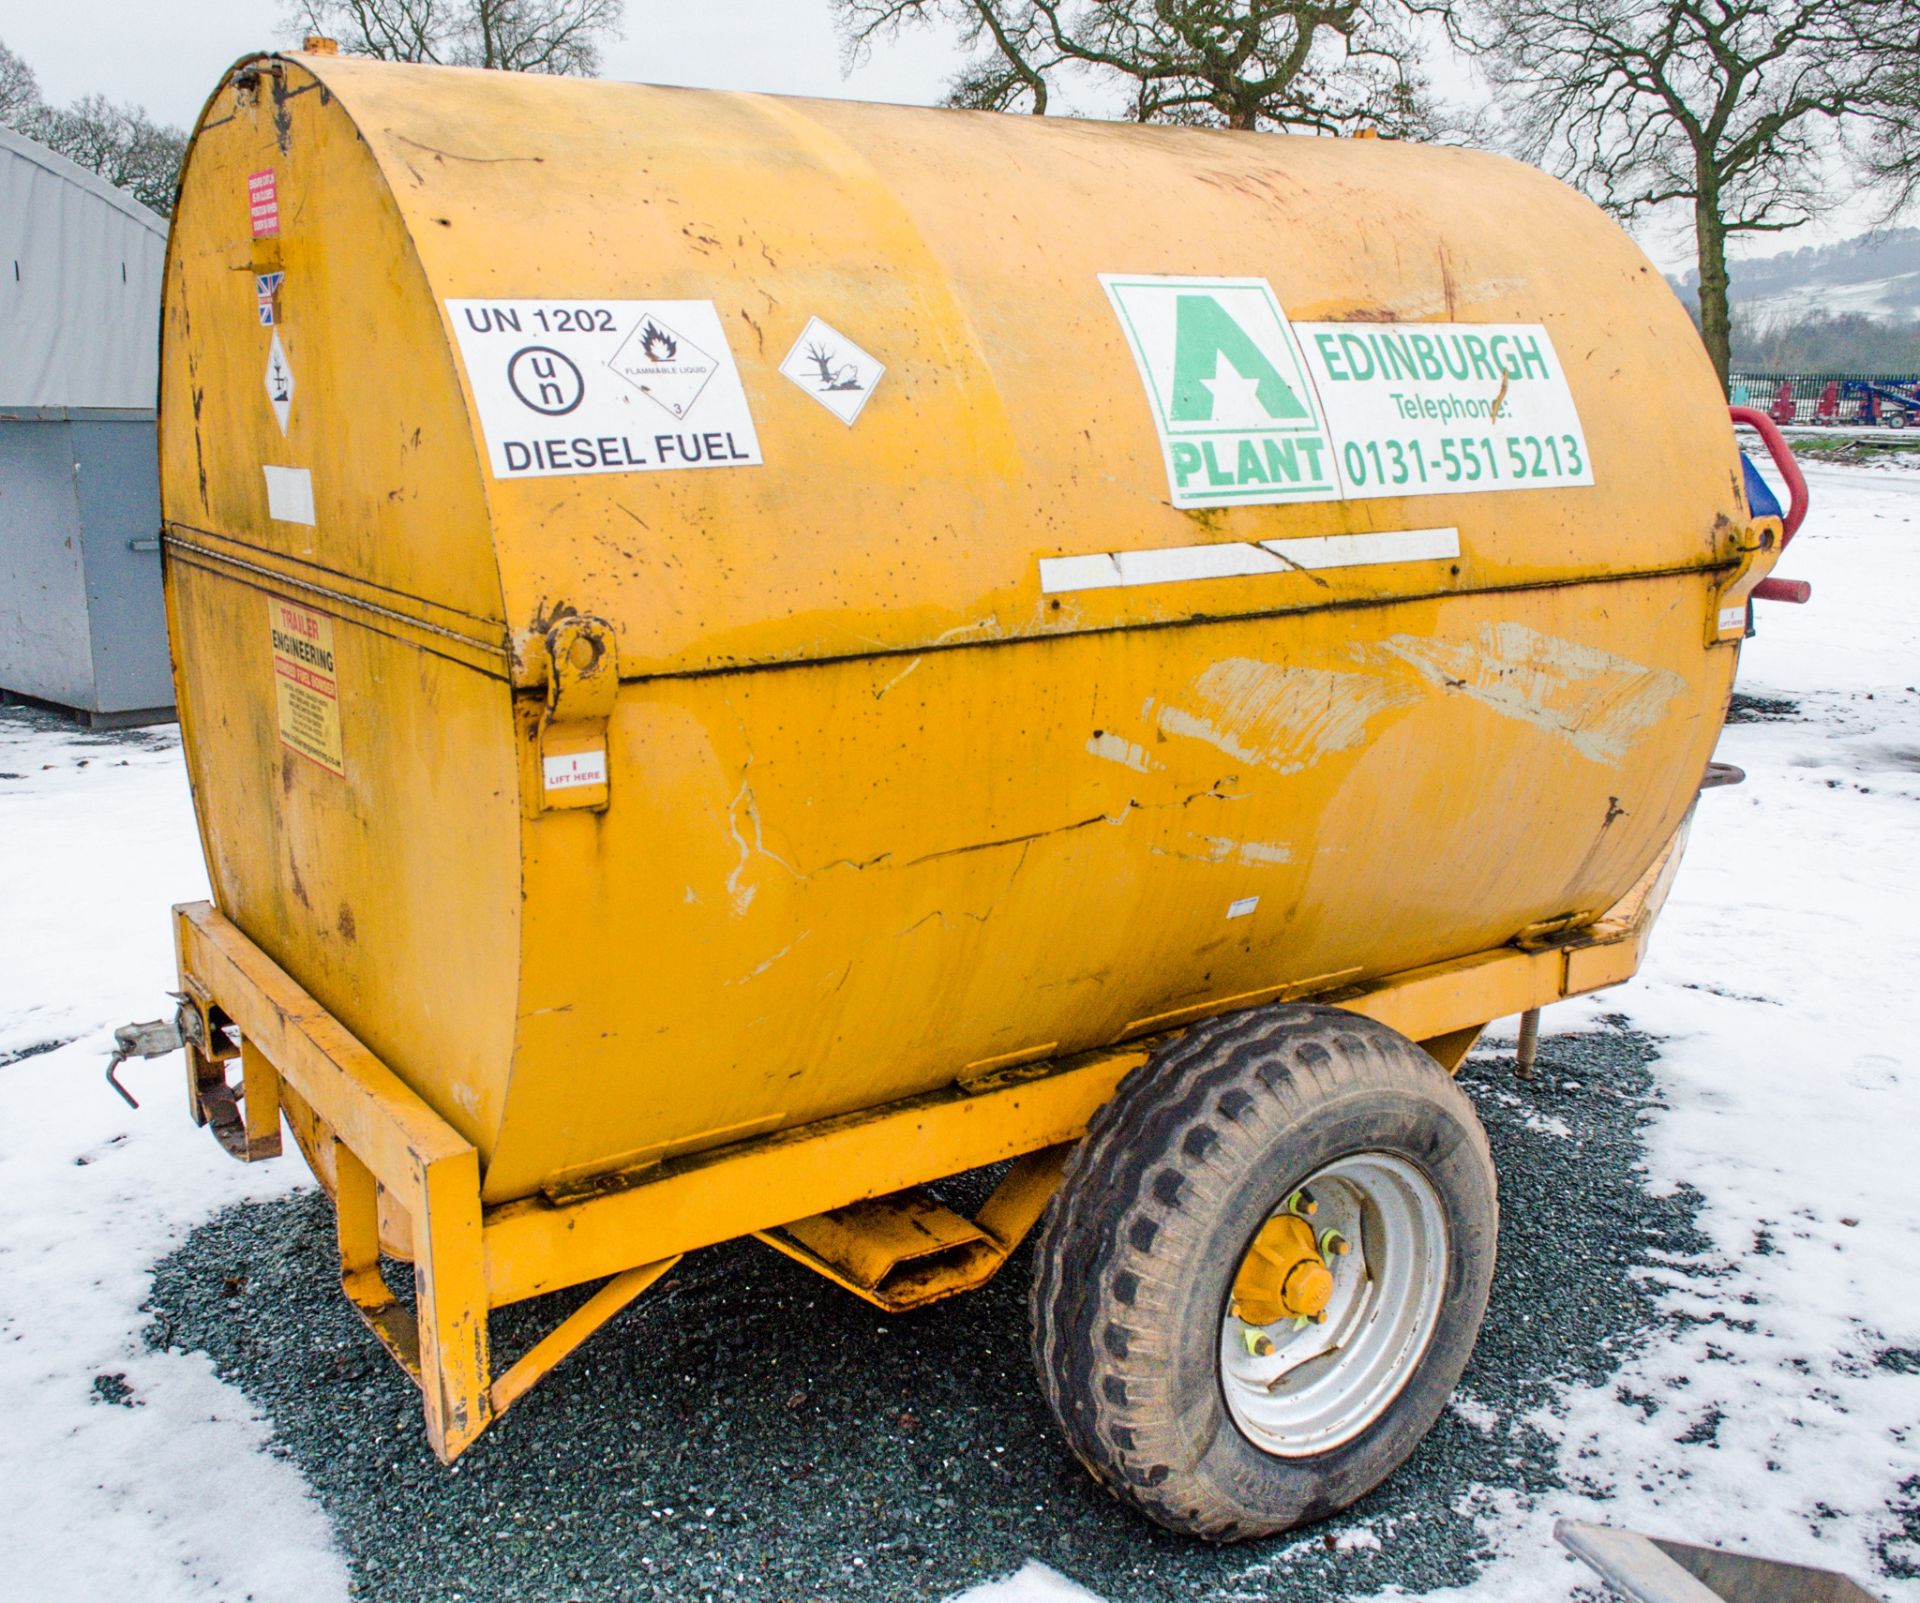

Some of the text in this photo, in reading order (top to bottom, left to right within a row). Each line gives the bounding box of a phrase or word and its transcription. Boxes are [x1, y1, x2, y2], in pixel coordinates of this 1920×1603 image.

[464, 308, 617, 333] UN 1202
[624, 365, 708, 376] FLAMMABLE LIQUID
[1313, 333, 1551, 381] EDINBURGH
[673, 403, 683, 415] 3
[1390, 394, 1514, 426] Telephone:
[503, 432, 750, 471] DIESEL FUEL
[1169, 437, 1326, 488] PLANT
[1343, 434, 1584, 486] 0131-551 5213
[281, 608, 319, 640] TRAILER
[271, 629, 334, 672] ENGINEERING
[549, 772, 600, 784] LIFT HERE
